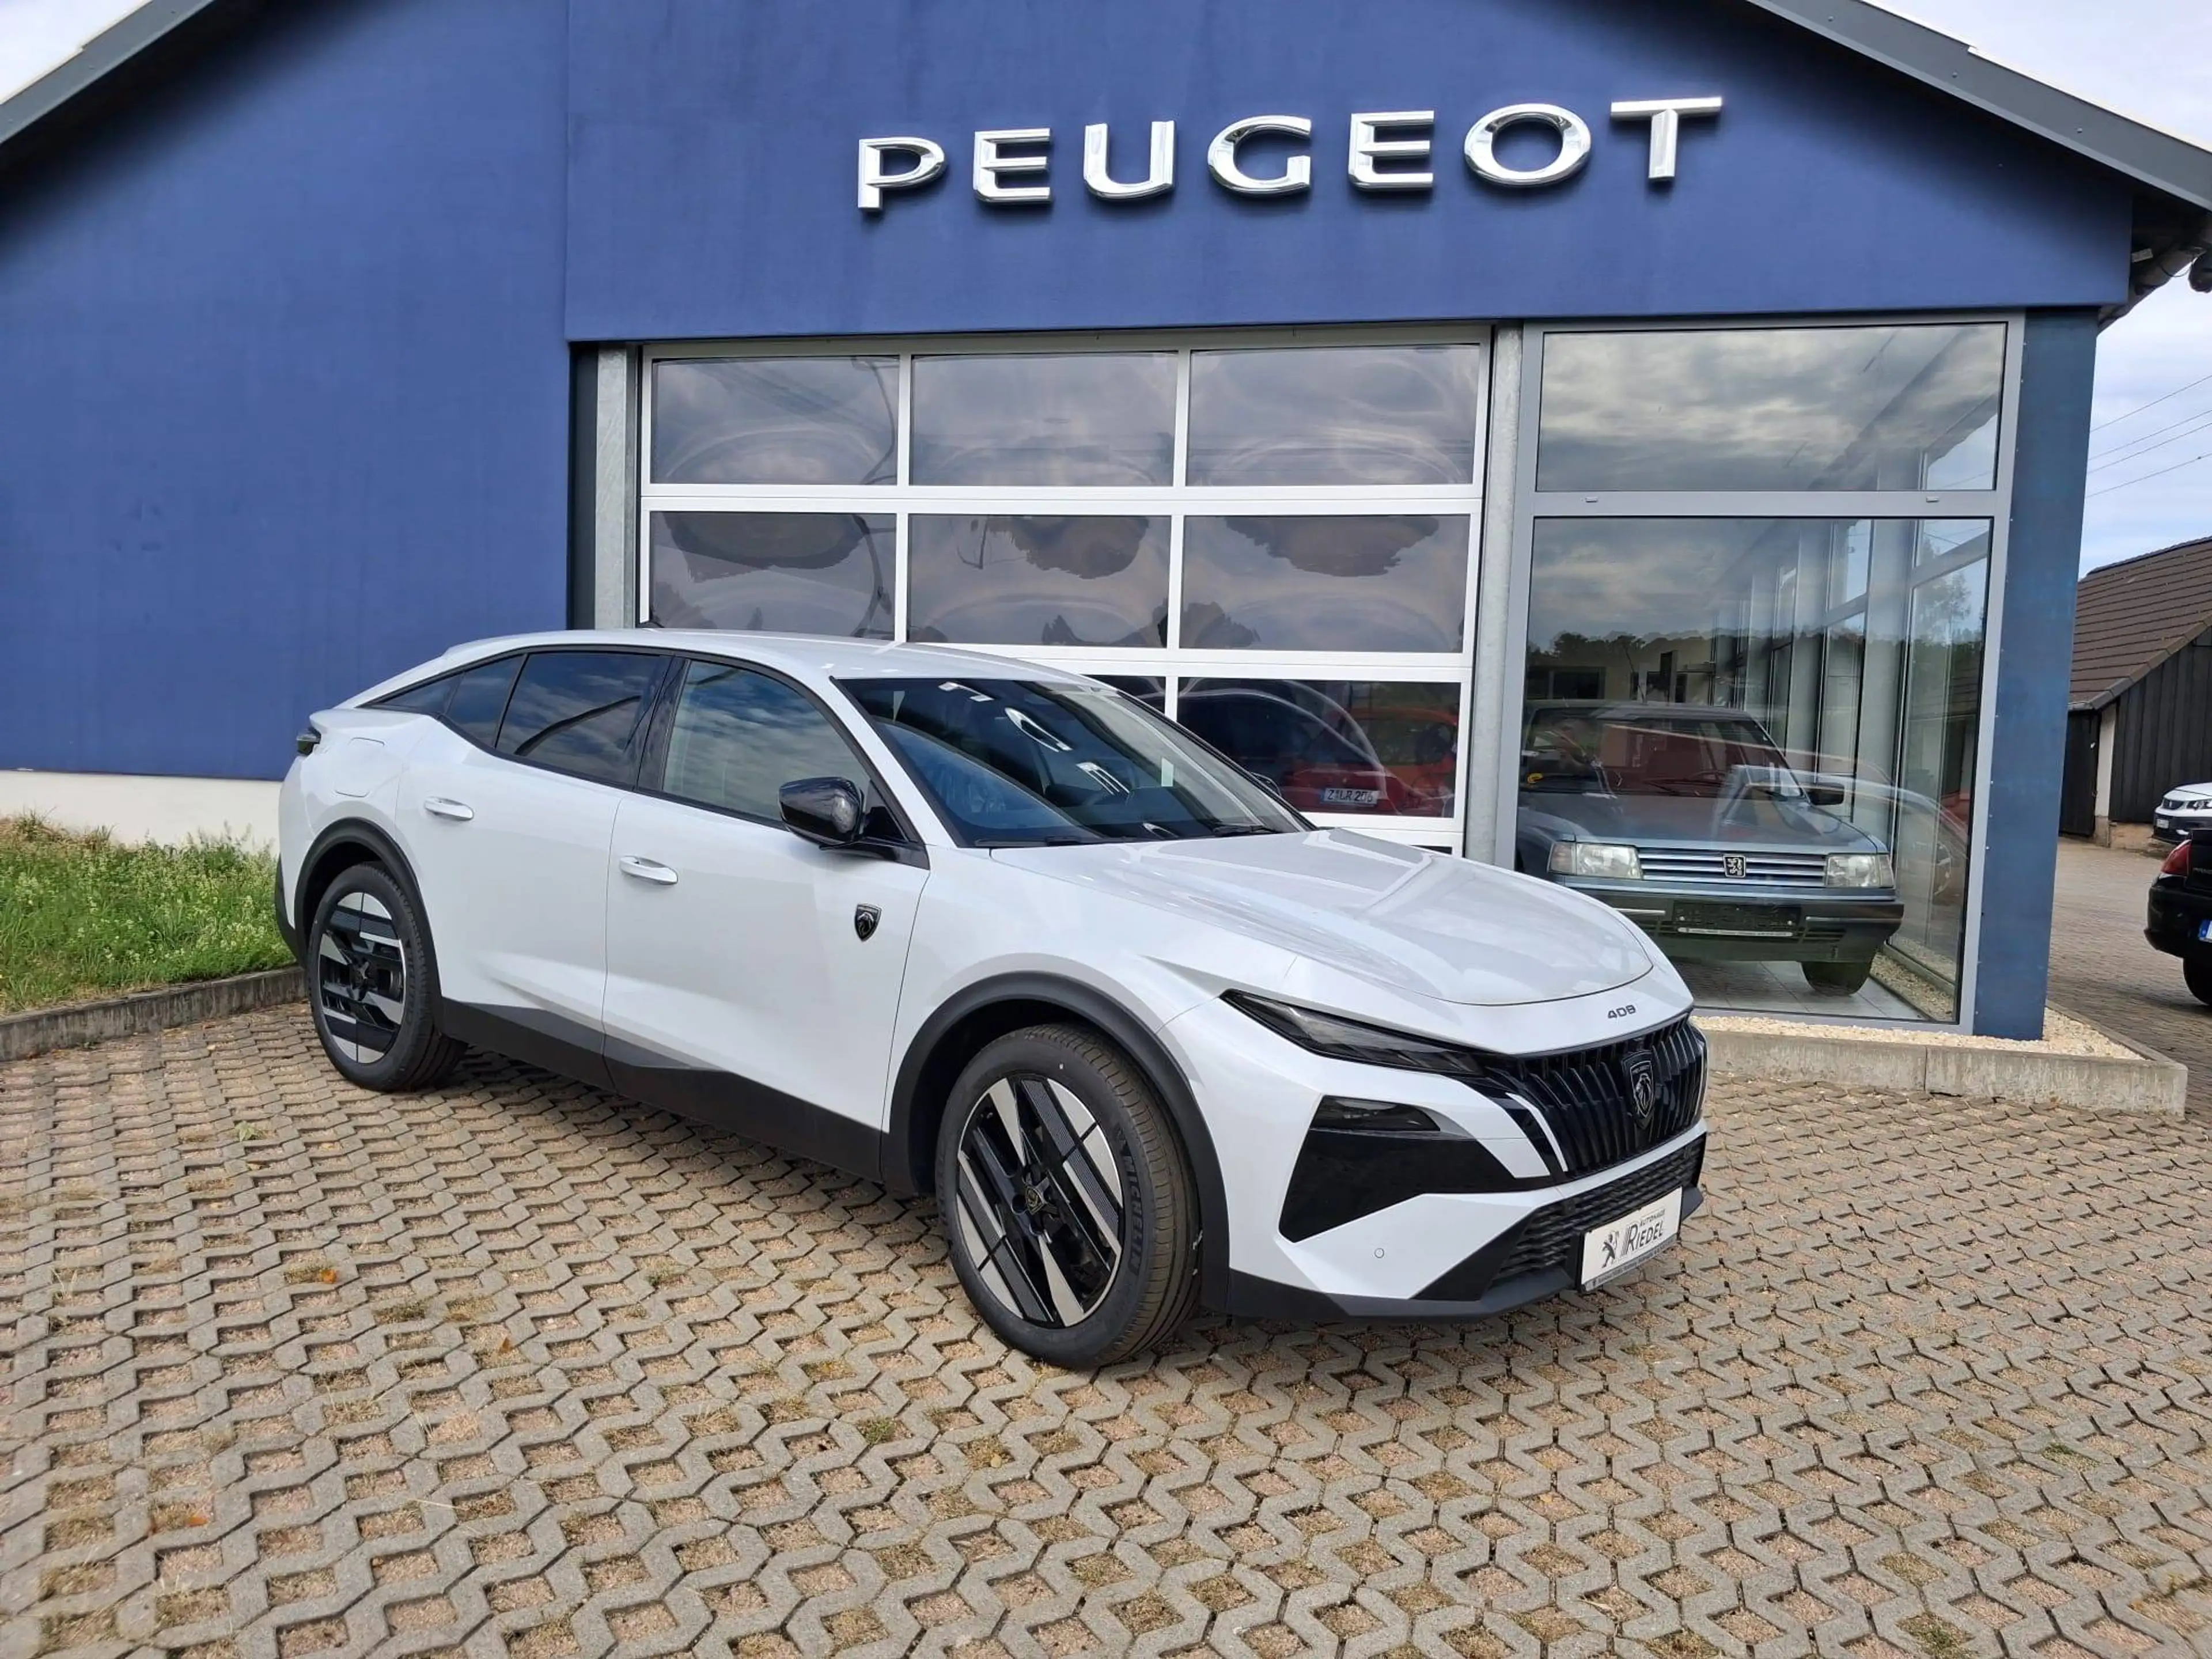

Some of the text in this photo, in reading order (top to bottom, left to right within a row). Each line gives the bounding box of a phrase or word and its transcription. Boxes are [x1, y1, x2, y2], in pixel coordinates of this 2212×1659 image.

[857, 96, 1722, 211] PEUGEOT
[1608, 1005, 1636, 1019] 408
[1627, 1219, 1664, 1252] RIEDEL
